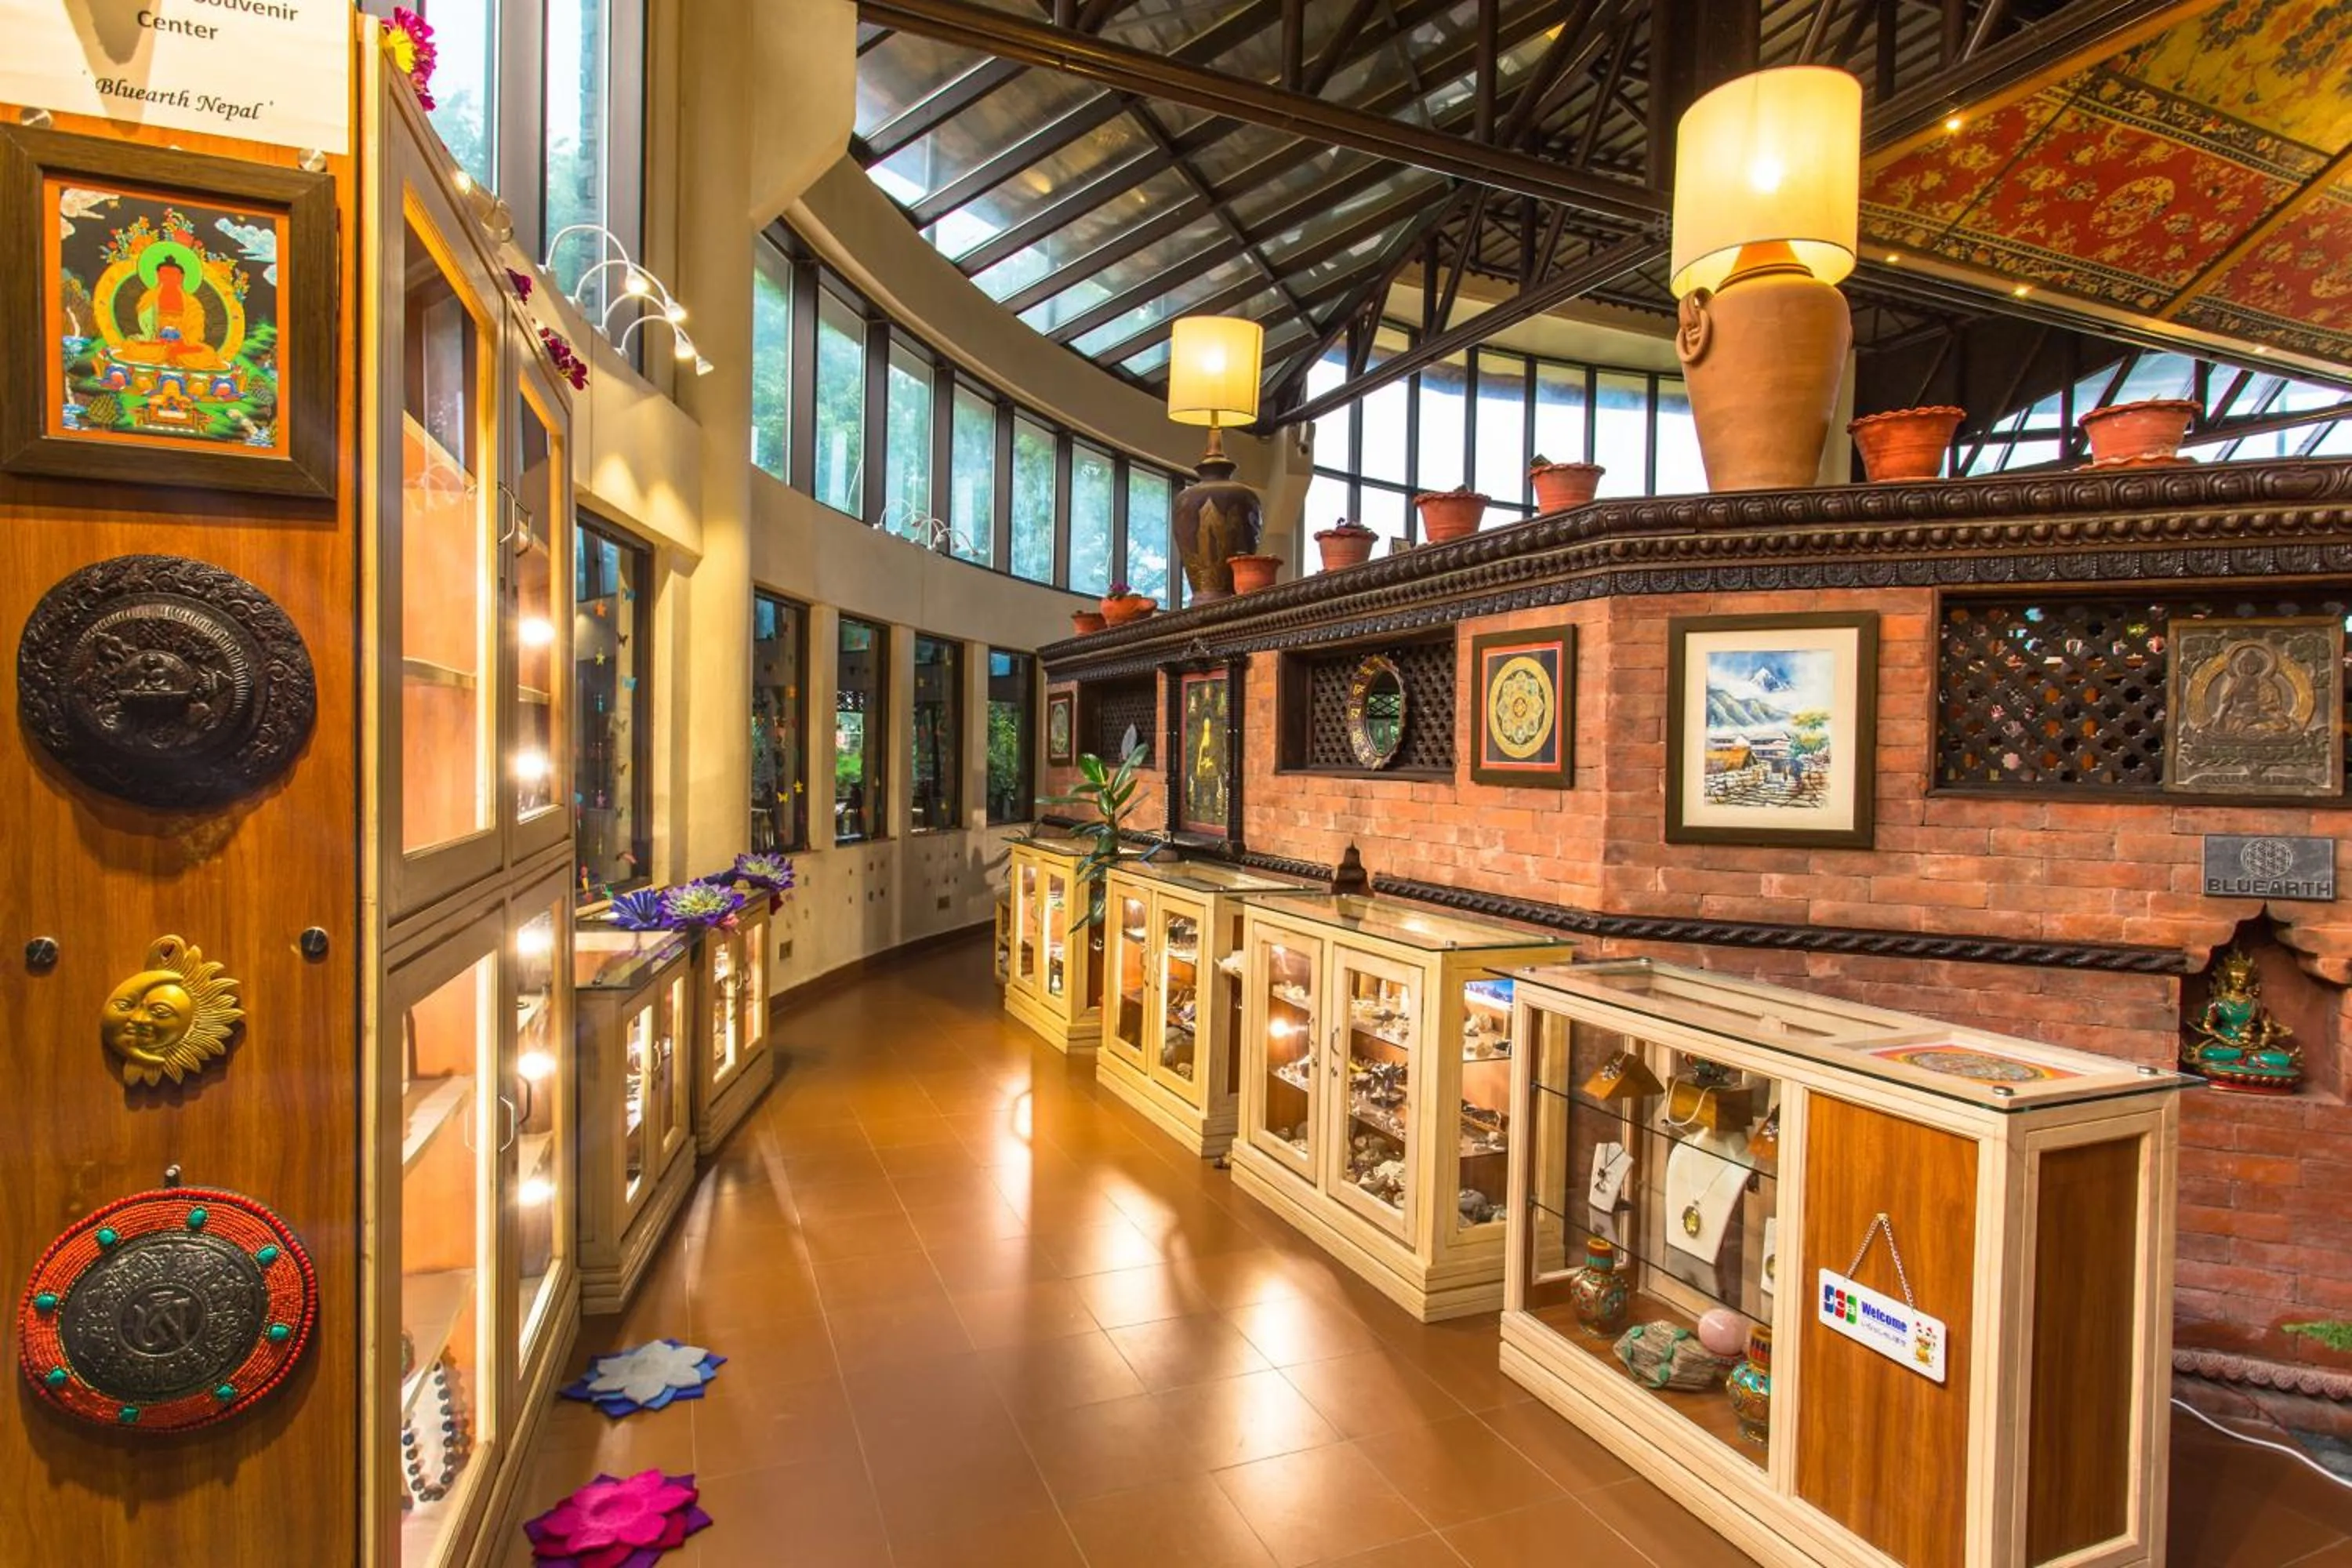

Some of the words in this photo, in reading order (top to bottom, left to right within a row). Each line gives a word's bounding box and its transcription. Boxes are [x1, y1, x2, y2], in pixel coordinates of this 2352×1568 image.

[137, 9, 219, 40] Center
[192, 0, 299, 20] ouvenir
[95, 78, 190, 107] Bluearth
[194, 95, 264, 121] Nepal
[2206, 878, 2331, 896] BLUEARTH
[1860, 1301, 1907, 1333] Welcome
